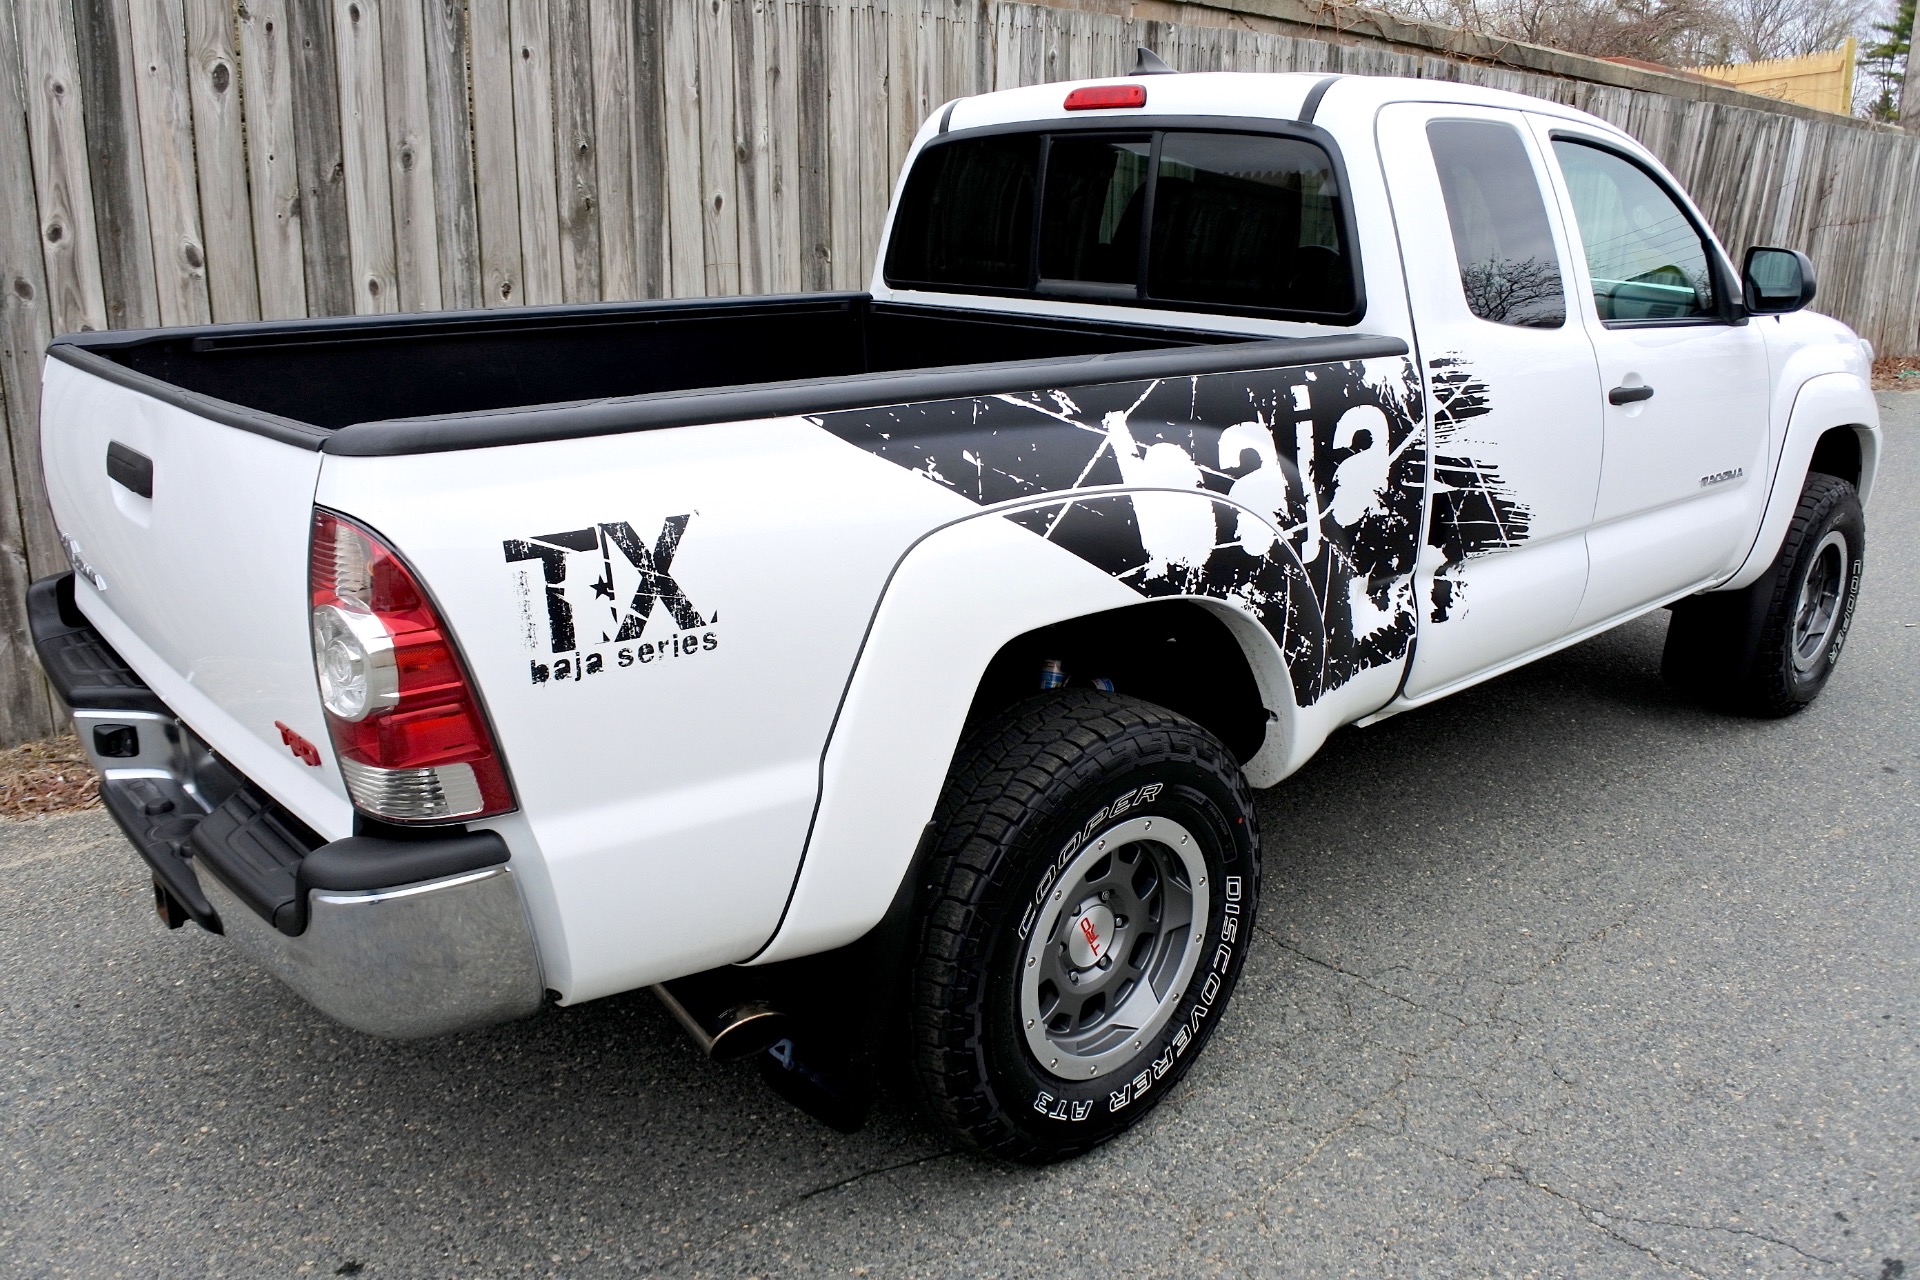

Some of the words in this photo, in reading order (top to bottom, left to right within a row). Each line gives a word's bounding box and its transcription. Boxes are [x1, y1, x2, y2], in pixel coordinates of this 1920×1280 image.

[1103, 385, 1390, 577] baja
[503, 514, 717, 653] TX
[1828, 559, 1861, 664] COOPER
[530, 652, 604, 685] baja
[618, 632, 718, 667] series
[1018, 783, 1163, 941] COOPER
[1080, 918, 1101, 956] TRD
[1110, 876, 1241, 1113] DISCOVERER
[1033, 1091, 1094, 1121] AT3
